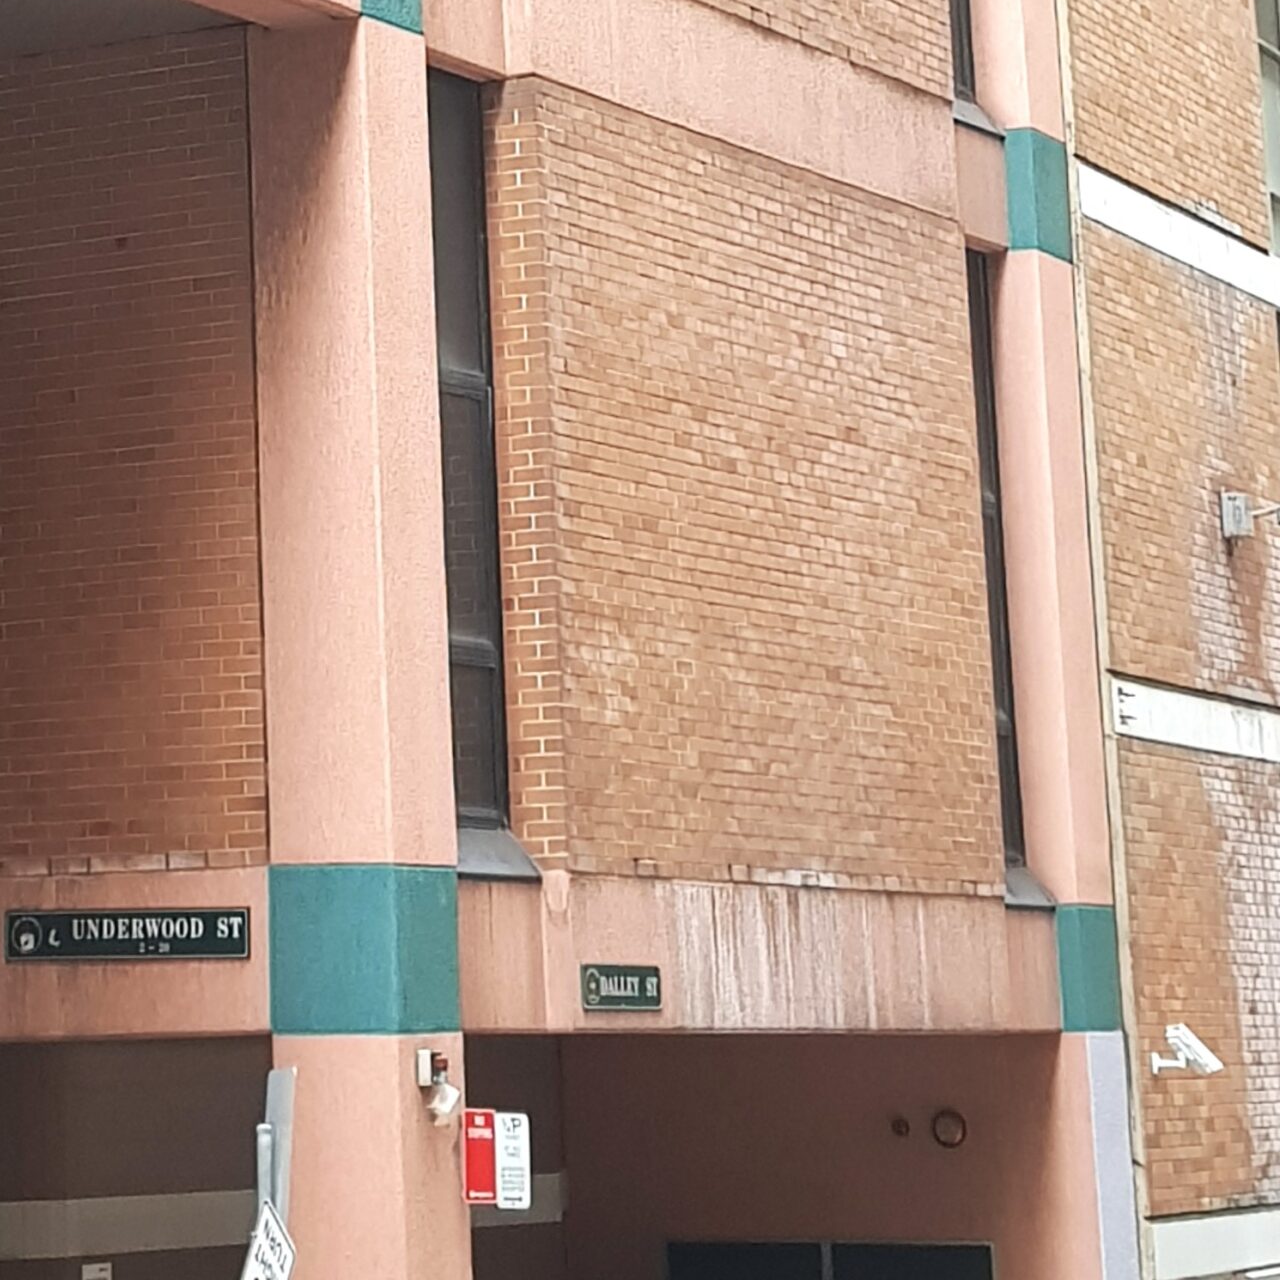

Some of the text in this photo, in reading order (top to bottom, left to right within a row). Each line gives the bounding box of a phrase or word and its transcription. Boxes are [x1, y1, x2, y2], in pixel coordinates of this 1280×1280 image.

[72, 916, 243, 940] UNDERWOOD ST
[645, 976, 658, 997] ST
